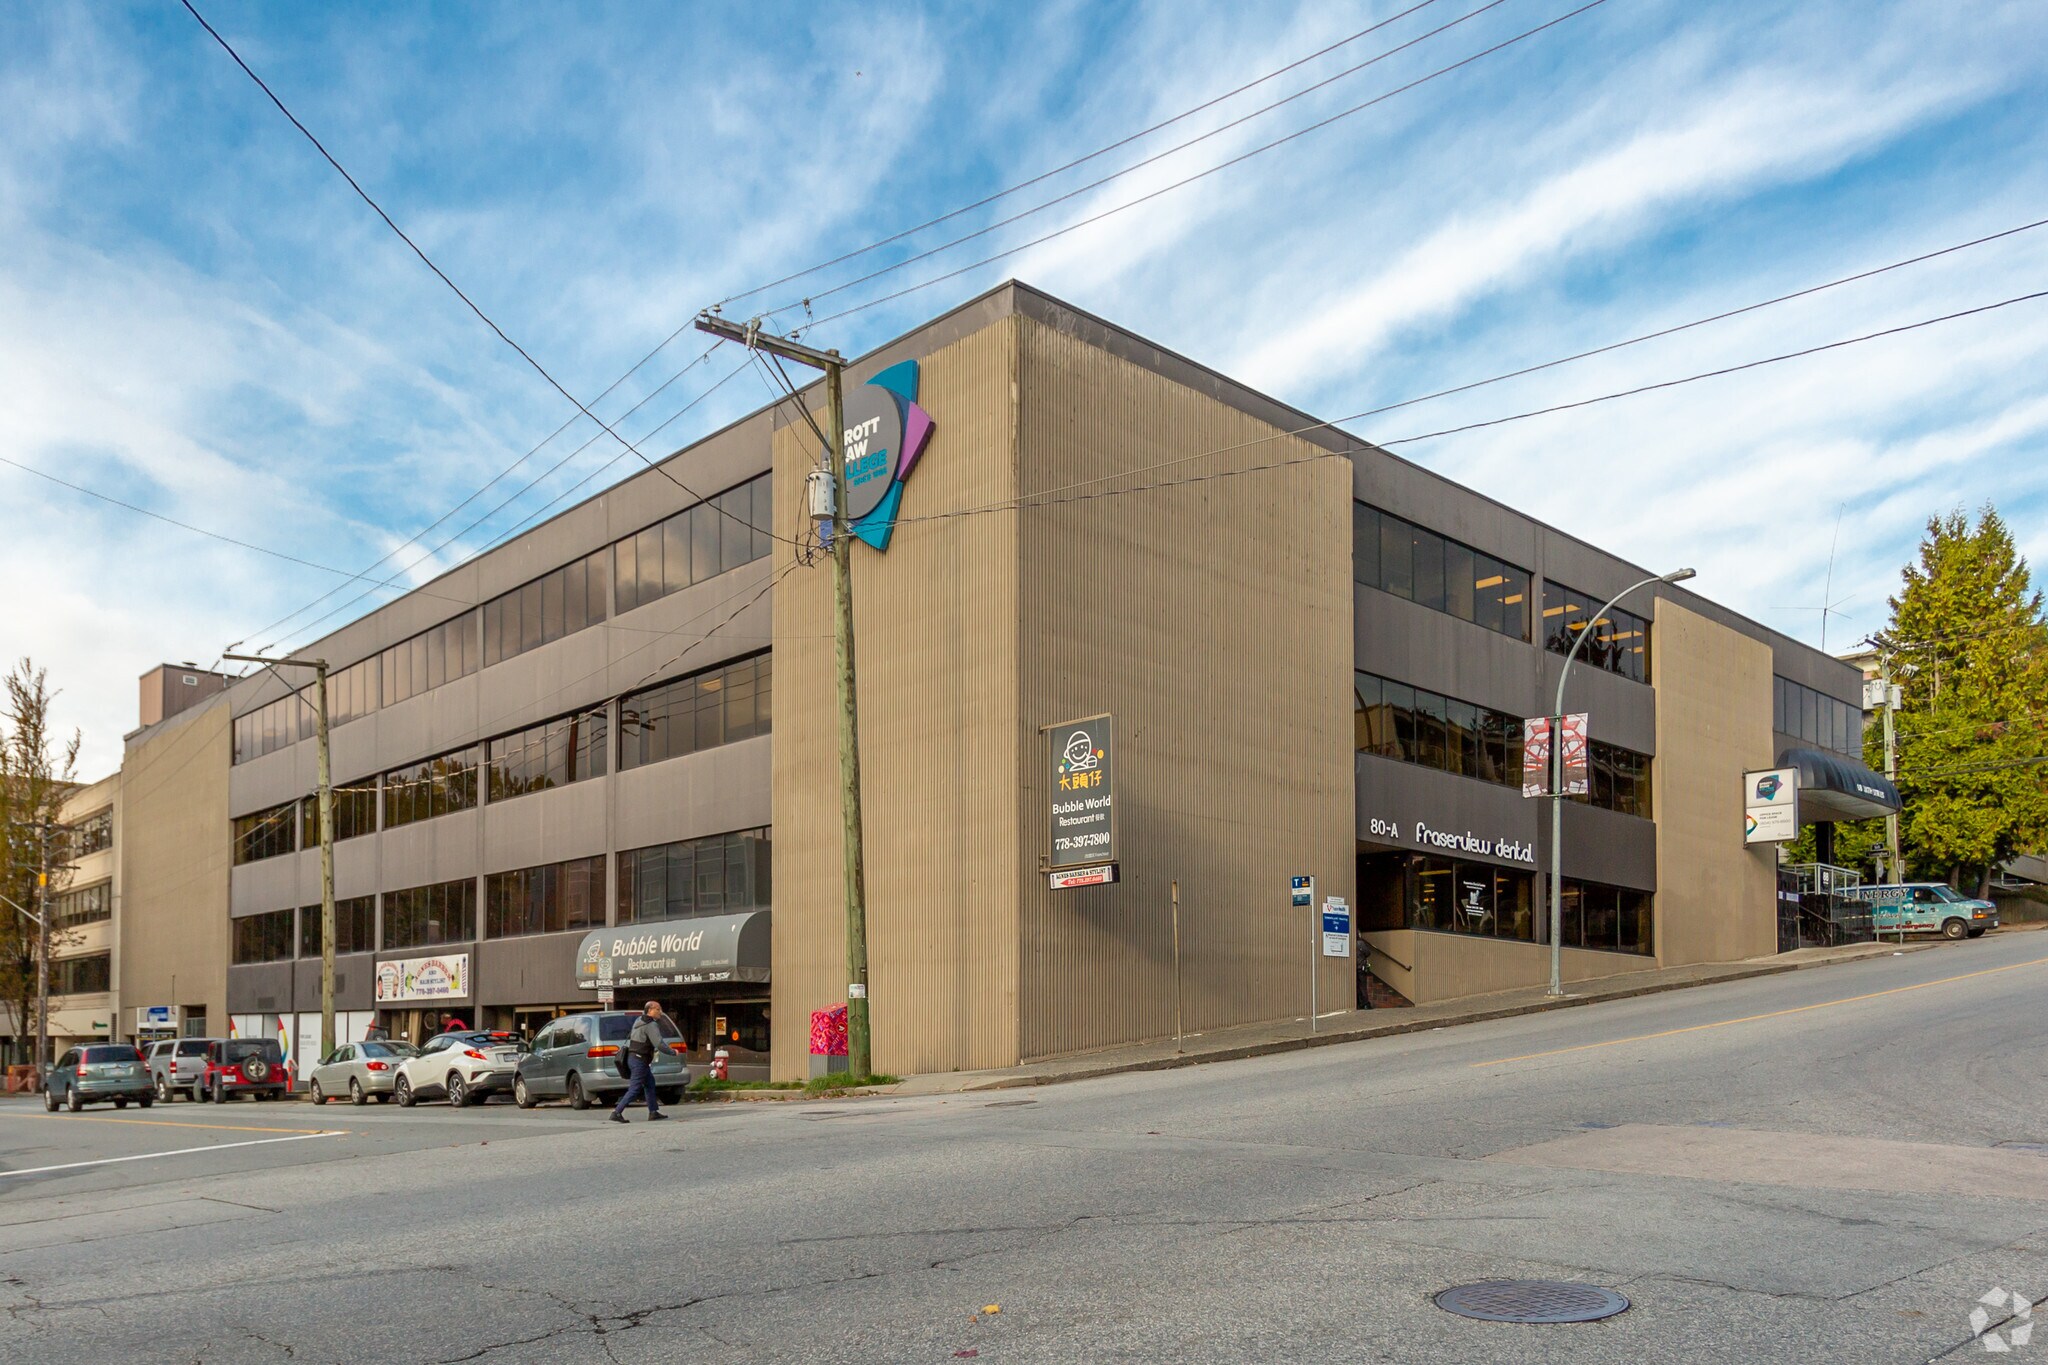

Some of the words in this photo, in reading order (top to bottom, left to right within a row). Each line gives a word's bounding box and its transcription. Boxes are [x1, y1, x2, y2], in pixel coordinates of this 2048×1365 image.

[844, 415, 881, 447] ROTT
[845, 439, 869, 463] AW
[846, 449, 888, 481] LLEGE
[1059, 769, 1102, 791] 大頭仔
[1052, 800, 1084, 815] Bubble
[1085, 795, 1111, 810] World
[1059, 813, 1095, 827] Restaurant
[1055, 832, 1110, 850] 778-397-7800
[1370, 818, 1399, 838] 80-A
[1495, 837, 1534, 863] dental
[1862, 888, 1909, 899] NERGY
[611, 935, 658, 957] Bubble
[661, 930, 704, 953] World
[627, 957, 665, 971] Restaurant
